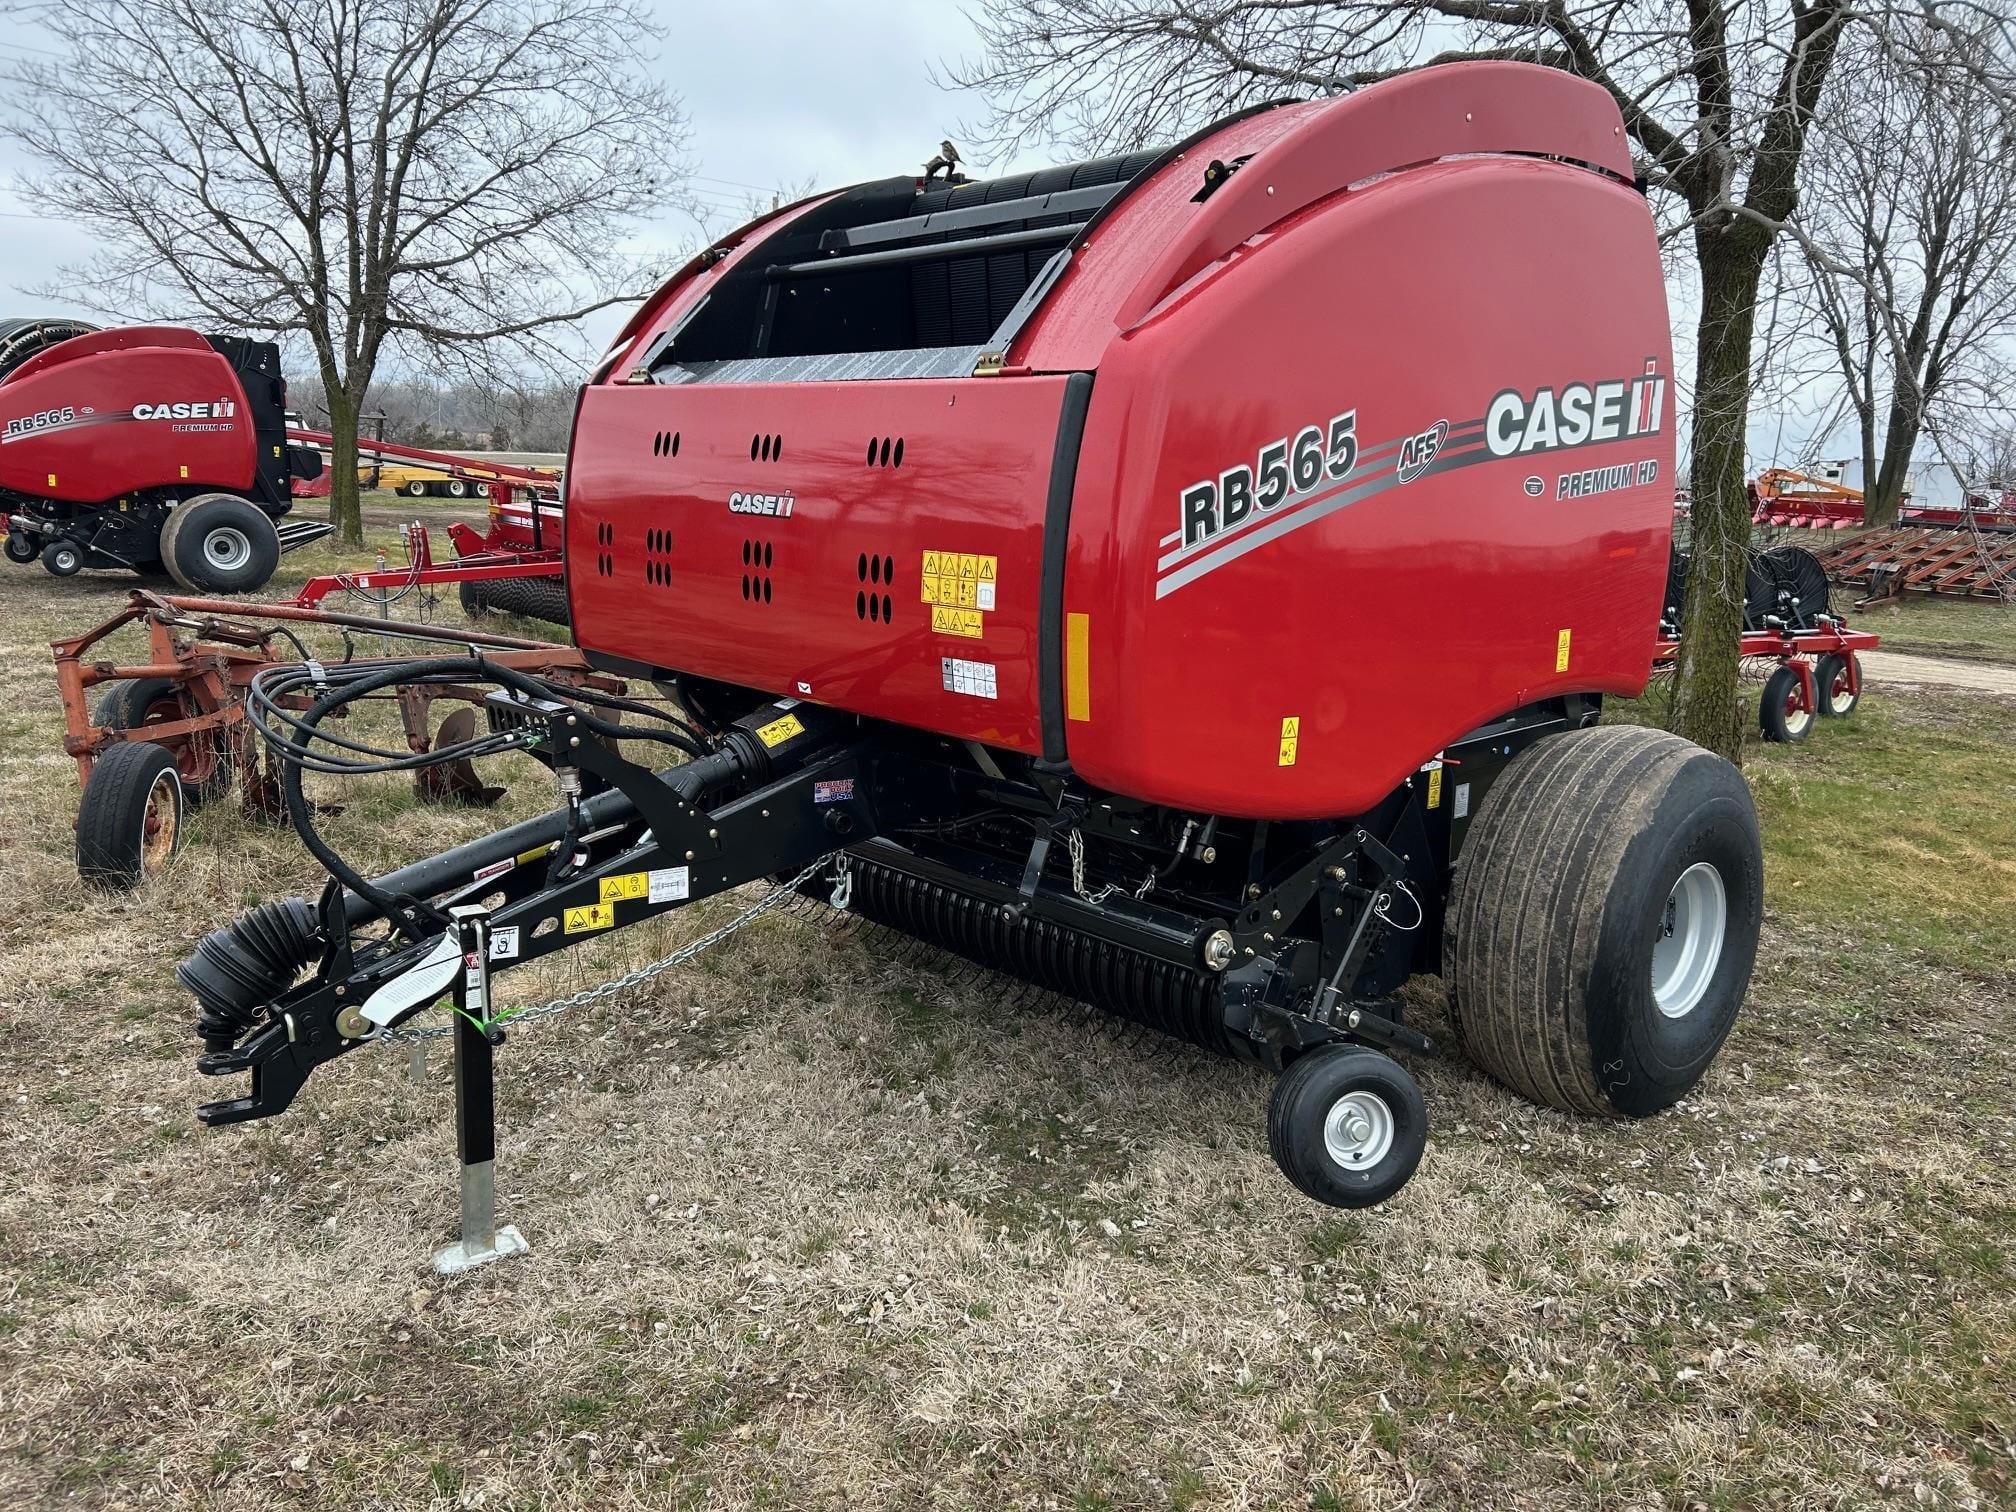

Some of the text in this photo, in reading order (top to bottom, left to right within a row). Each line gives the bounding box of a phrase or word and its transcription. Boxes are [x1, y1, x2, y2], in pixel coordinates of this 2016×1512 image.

[8, 407, 75, 434] RB565
[132, 402, 208, 420] CASE
[172, 423, 234, 432] PREMIUM HD
[1487, 383, 1624, 456] CASE
[1396, 429, 1440, 473] AFS
[1180, 408, 1358, 553] RB565
[1556, 463, 1635, 501] PREMIUM
[1636, 459, 1659, 486] HD
[729, 492, 777, 515] CASE
